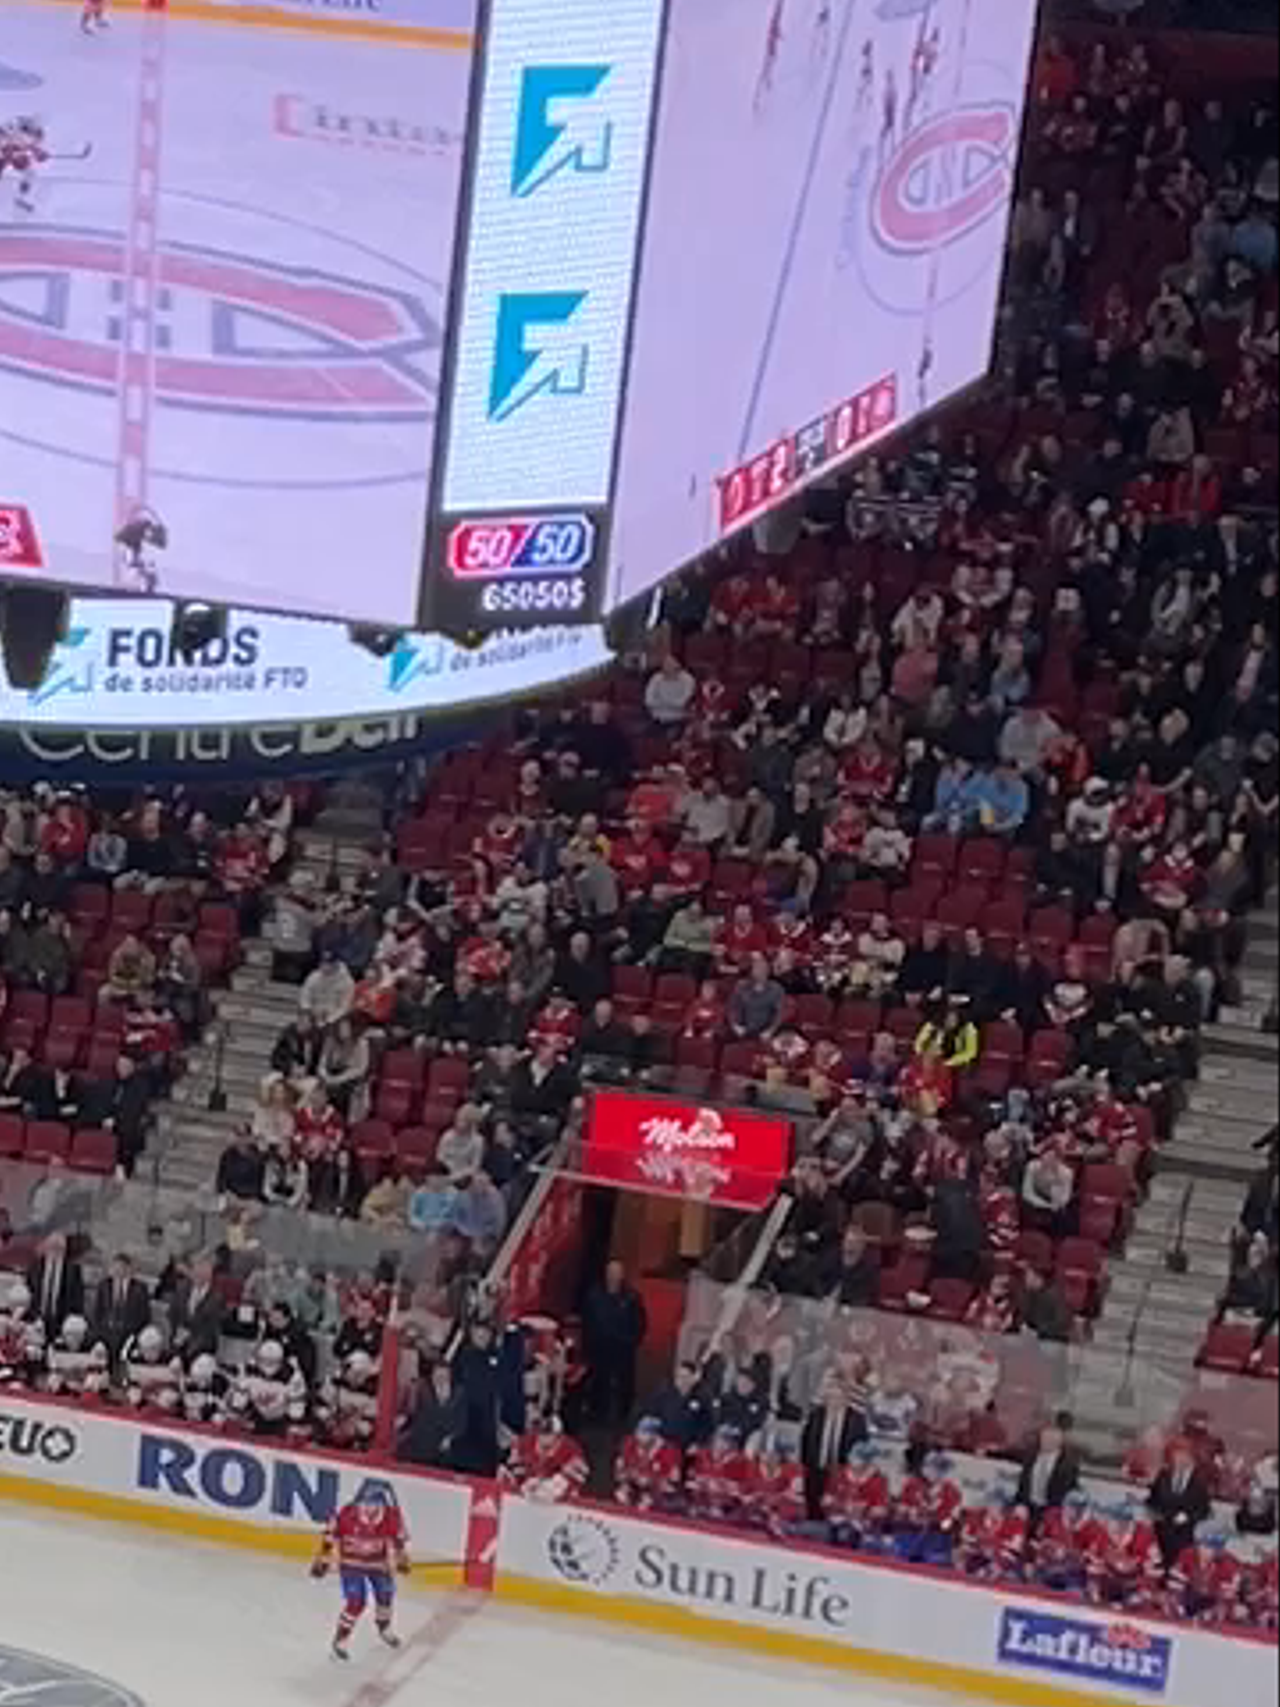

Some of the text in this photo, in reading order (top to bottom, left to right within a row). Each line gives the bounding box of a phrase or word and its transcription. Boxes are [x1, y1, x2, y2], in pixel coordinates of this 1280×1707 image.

[463, 520, 582, 569] 50/50
[635, 1543, 849, 1627] Sun Life
[1002, 1616, 1163, 1681] Lafleur
